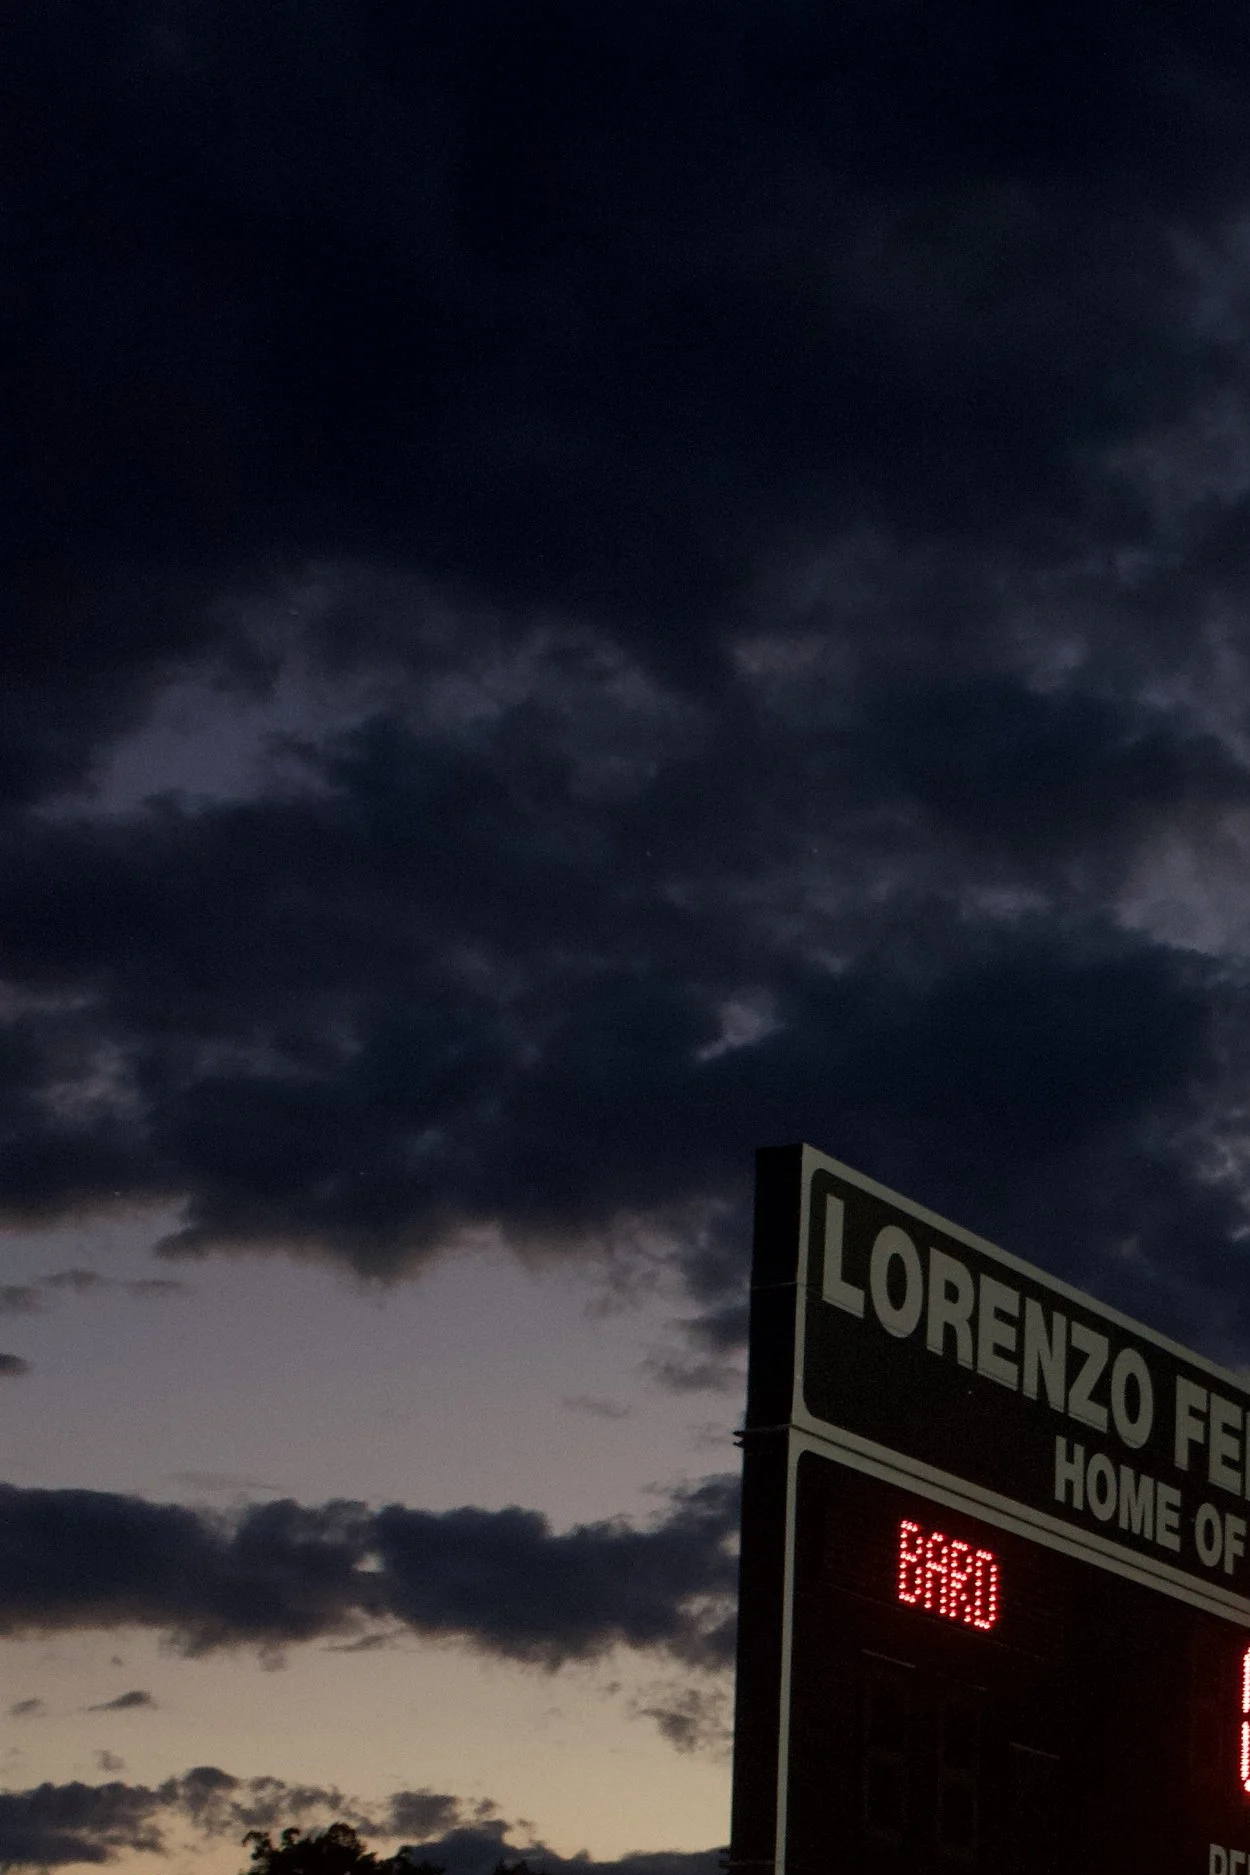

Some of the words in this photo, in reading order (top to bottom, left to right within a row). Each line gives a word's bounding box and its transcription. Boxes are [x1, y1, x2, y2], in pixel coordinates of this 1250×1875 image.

[823, 1194, 1154, 1448] LORENZO
[899, 1520, 998, 1630] BARD
[1054, 1435, 1182, 1553] HOME
[1195, 1503, 1246, 1575] OF
